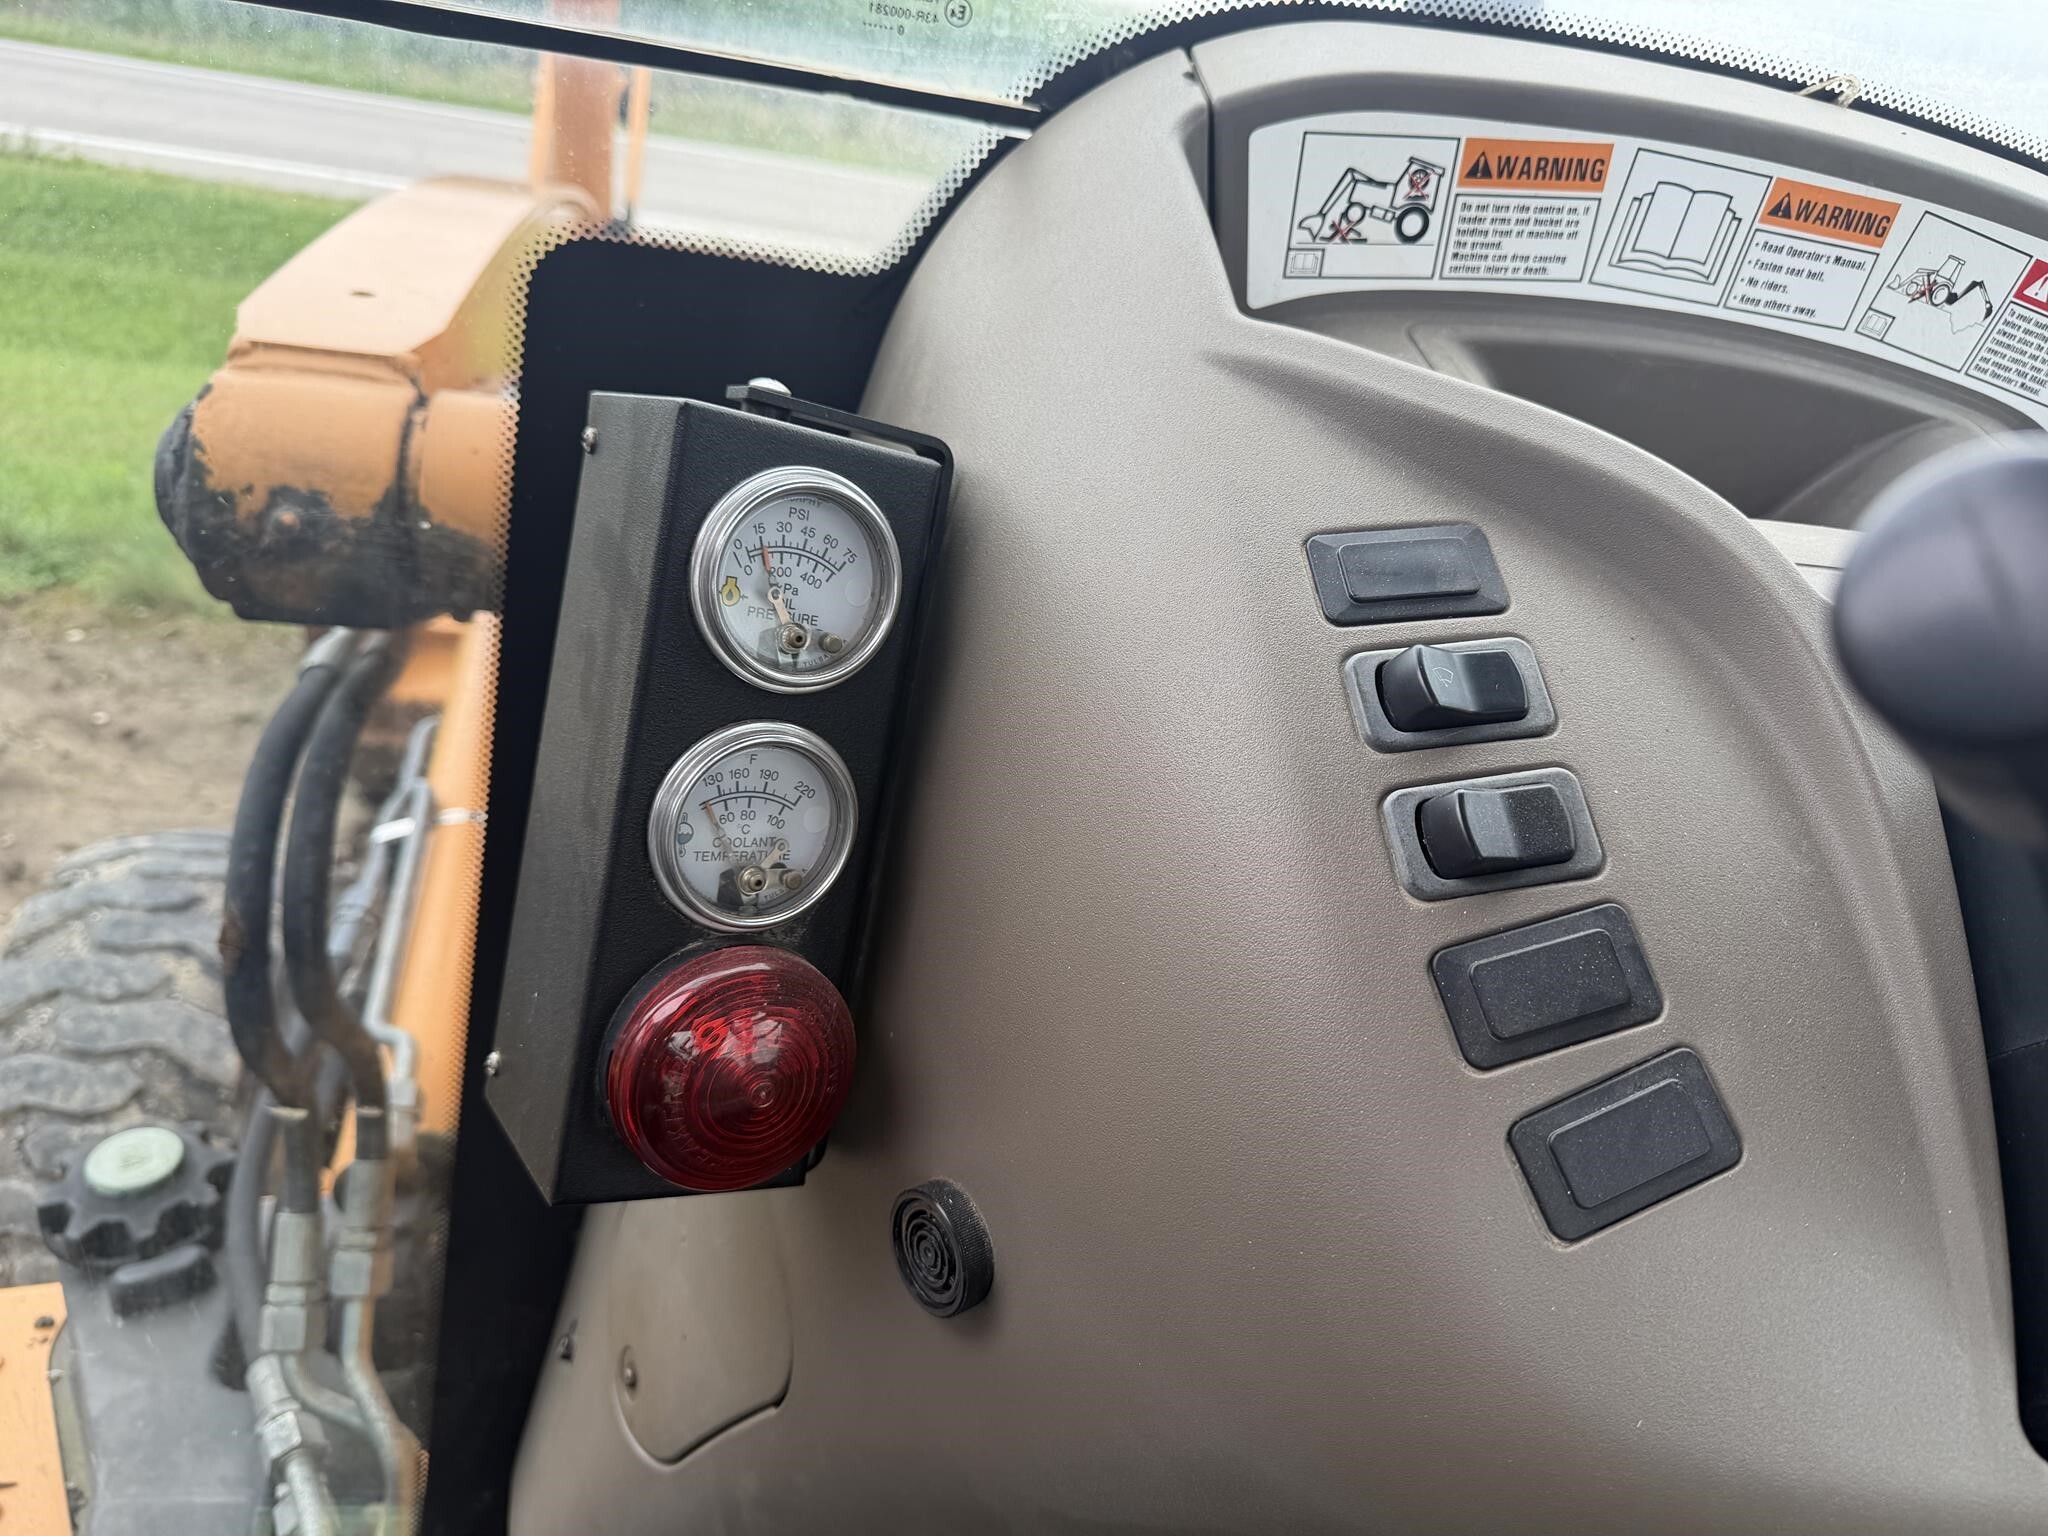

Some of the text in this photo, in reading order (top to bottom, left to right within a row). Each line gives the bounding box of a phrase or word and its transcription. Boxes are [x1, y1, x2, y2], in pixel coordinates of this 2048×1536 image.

[1496, 154, 1606, 183] WARNING
[1460, 202, 1472, 213] Do
[1474, 203, 1490, 213] not
[1491, 203, 1510, 214] turn
[1512, 204, 1531, 215] ride
[1532, 205, 1565, 216] control
[1795, 198, 1890, 238] WARNING
[1457, 215, 1580, 229] loader arms and bucket are
[1455, 227, 1580, 241] holding front of machine off
[1452, 239, 1467, 250] the
[1450, 251, 1568, 266] Machine can drop causing
[1760, 240, 1866, 272] Read Operator's Manual.
[1447, 264, 1481, 275] serious
[1483, 264, 1509, 277] injury
[1510, 266, 1521, 276] or
[1752, 258, 1824, 282] Fasten seat belt.
[1745, 275, 1788, 295] No riders.
[1738, 293, 1816, 318] Keep others away.
[2008, 308, 2016, 318] To
[2016, 311, 2033, 324] avoid
[1972, 363, 1989, 376] Read
[2012, 368, 2028, 380] PARK
[788, 506, 810, 521] PSI
[733, 521, 858, 564] 0 15 30 45 60 75
[744, 564, 823, 590] 0 200 400
[747, 606, 819, 627] PREURE
[703, 767, 816, 799] 130 160 190 220
[719, 810, 786, 830] 60 80 100
